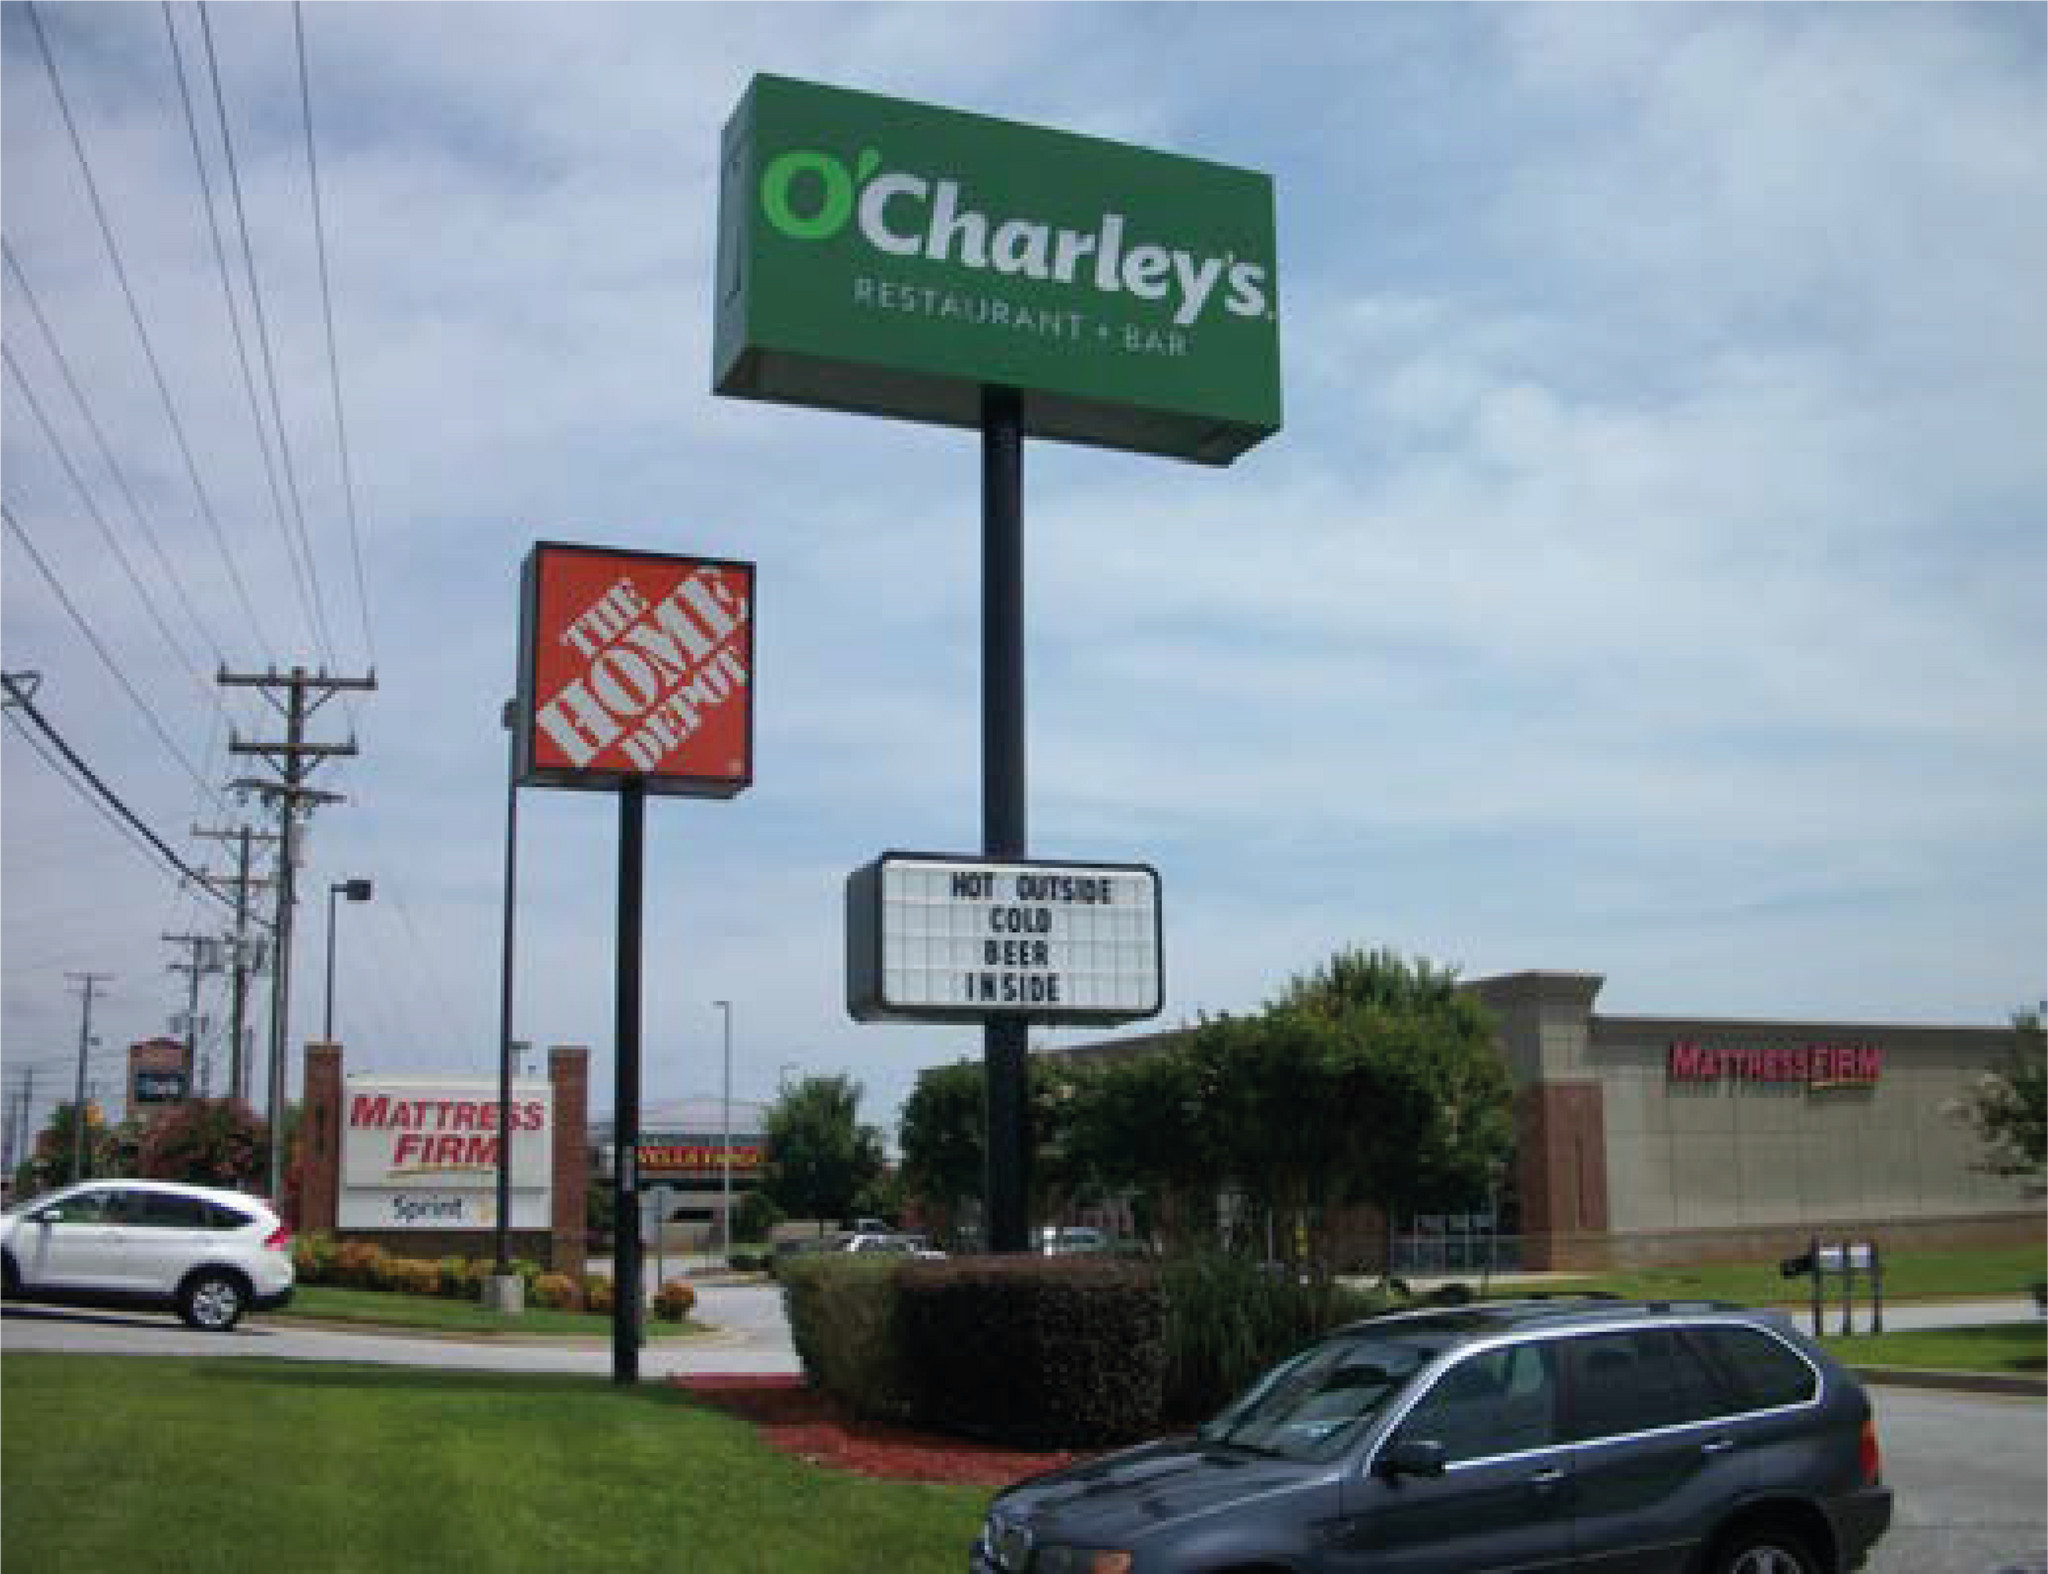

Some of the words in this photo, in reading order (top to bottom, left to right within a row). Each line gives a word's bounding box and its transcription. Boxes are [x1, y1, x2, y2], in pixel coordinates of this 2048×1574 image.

[854, 278, 1086, 338] RESTAURANT
[1124, 322, 1187, 356] BAR
[560, 577, 649, 658] THE
[537, 566, 746, 768] HOME
[622, 647, 747, 772] DEPOT
[952, 871, 994, 897] HOT
[1016, 876, 1112, 904] OUTSIDE
[989, 907, 1052, 933] COLD
[984, 940, 1049, 965] BEER
[965, 973, 1061, 1001] INSIDE
[393, 1133, 504, 1163] FIRM
[393, 1194, 463, 1222] Sprint
